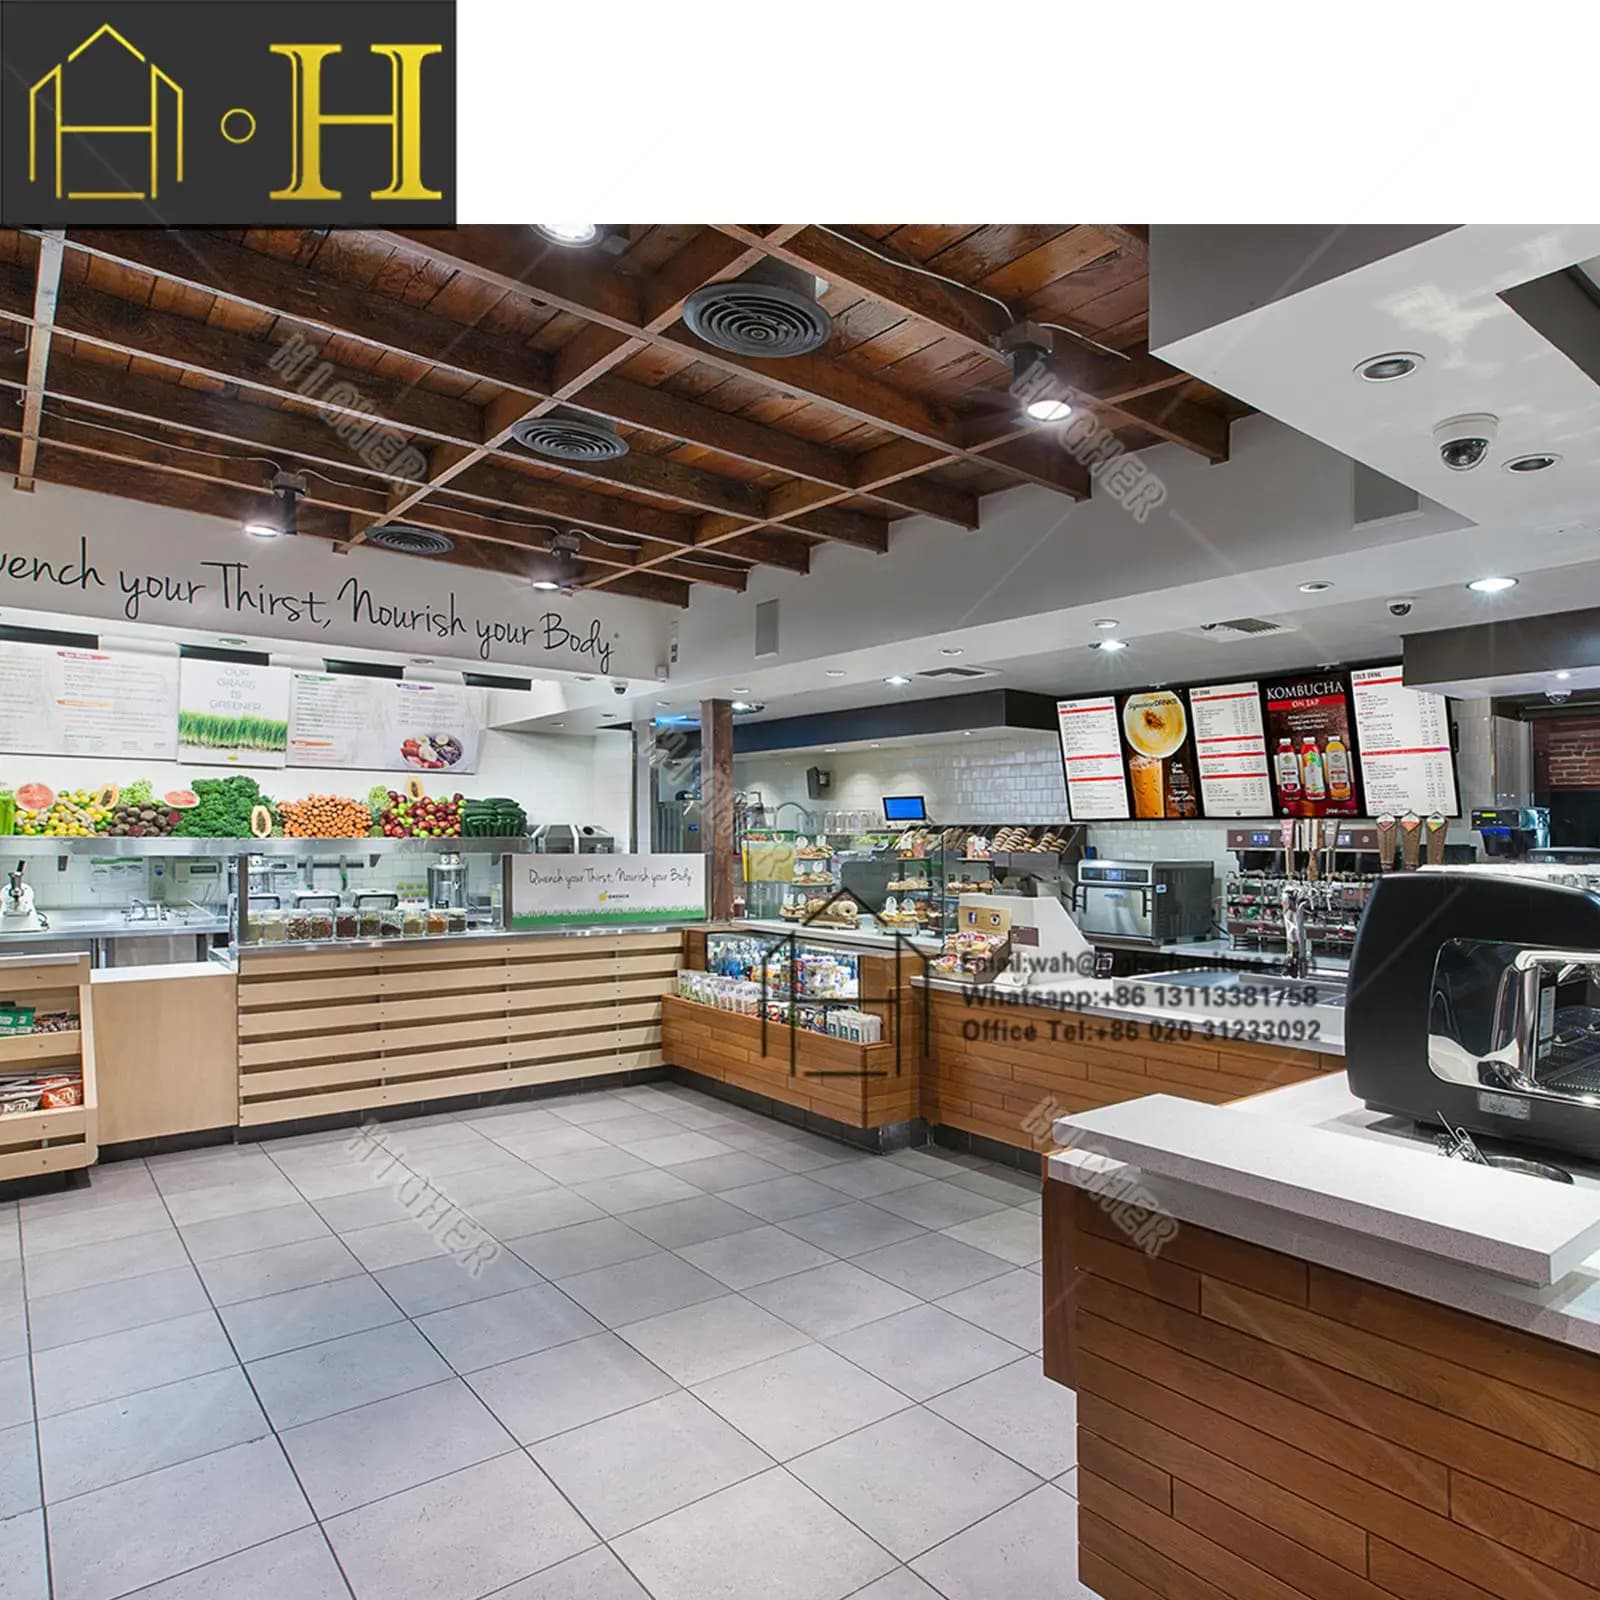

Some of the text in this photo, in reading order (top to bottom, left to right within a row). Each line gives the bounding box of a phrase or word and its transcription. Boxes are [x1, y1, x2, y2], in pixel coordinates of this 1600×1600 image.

[0, 536, 614, 674] ench your Thirst, Nourish your Body
[224, 667, 250, 677] OUR
[216, 678, 257, 690] GRASS
[1266, 680, 1344, 700] KOMBUCHA
[209, 699, 262, 712] GREENER
[528, 867, 563, 887] Quench
[566, 870, 584, 889] your
[615, 867, 648, 884] Nourish
[651, 871, 667, 889] your
